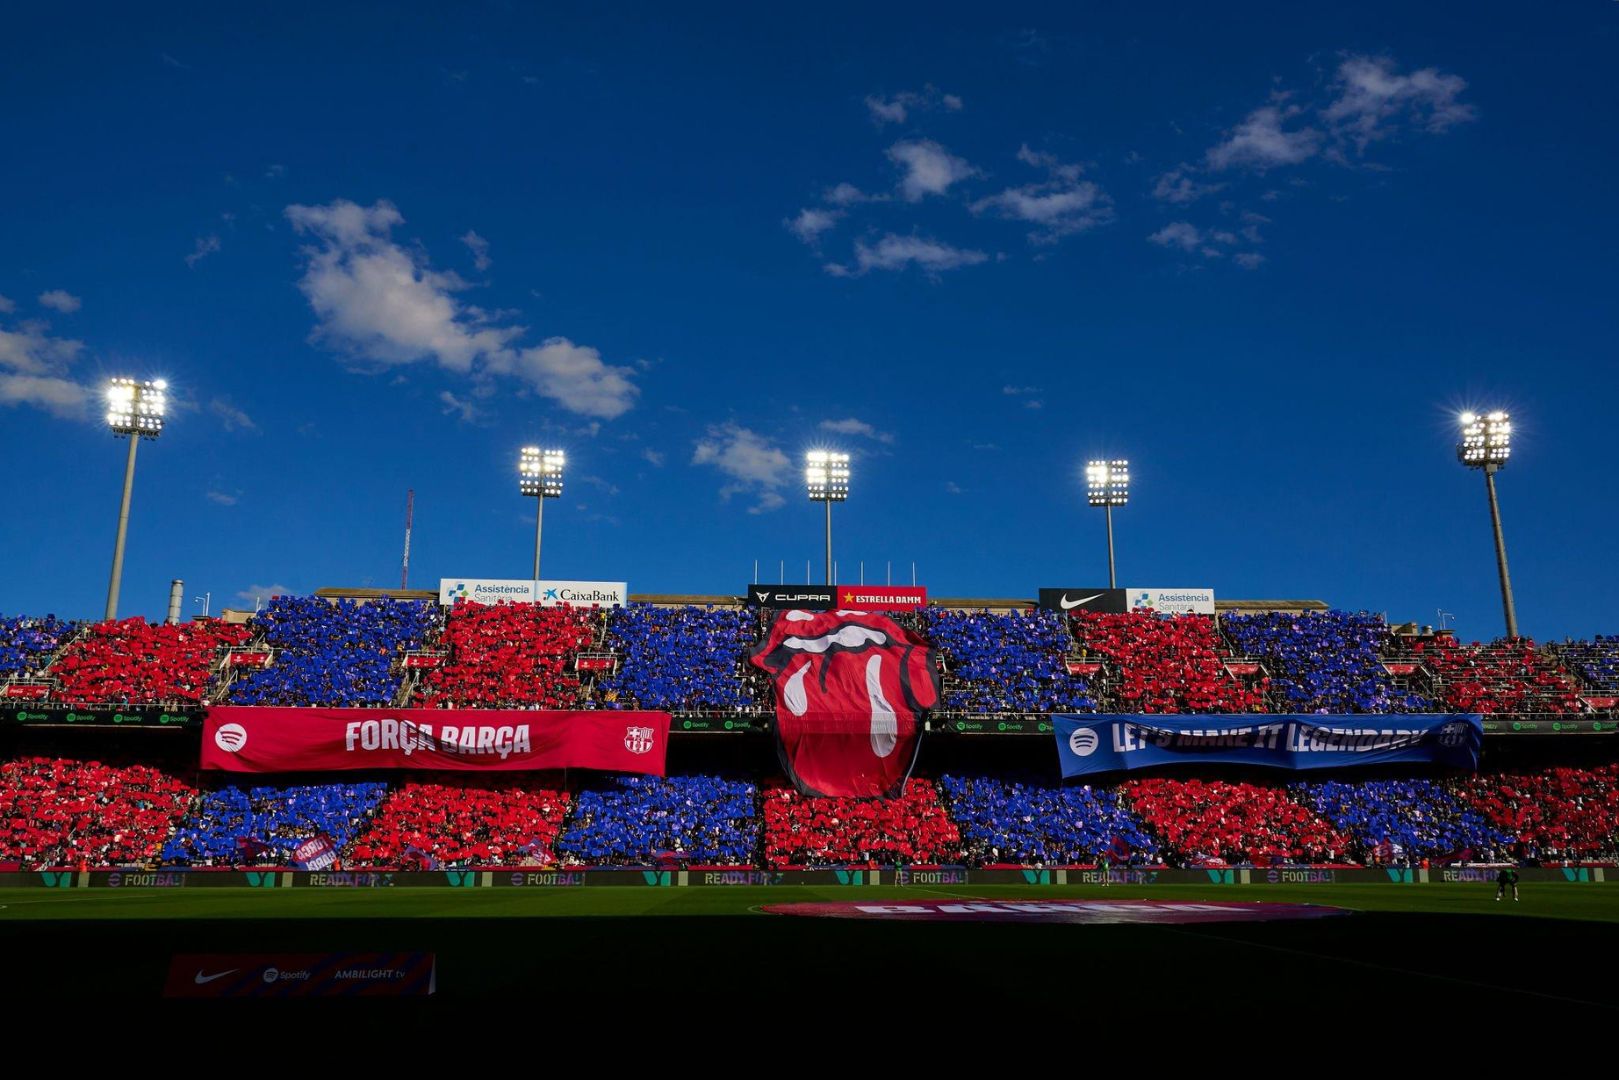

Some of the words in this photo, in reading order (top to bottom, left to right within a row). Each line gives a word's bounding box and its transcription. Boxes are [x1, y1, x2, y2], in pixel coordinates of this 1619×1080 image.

[474, 584, 530, 593] Assistència
[560, 588, 619, 601] CaixaBank
[856, 595, 895, 604] ESTRELLA
[895, 596, 922, 604] DAMM
[1158, 593, 1209, 602] Assistència
[345, 719, 436, 756] FORÇA
[440, 724, 532, 760] BARÇA
[1112, 722, 1174, 753] LET'S
[1176, 727, 1252, 748] MAKE
[1253, 723, 1285, 750] IT
[280, 970, 312, 982] Spotify
[334, 969, 394, 979] AMBILIGHT
[395, 970, 406, 978] tv
